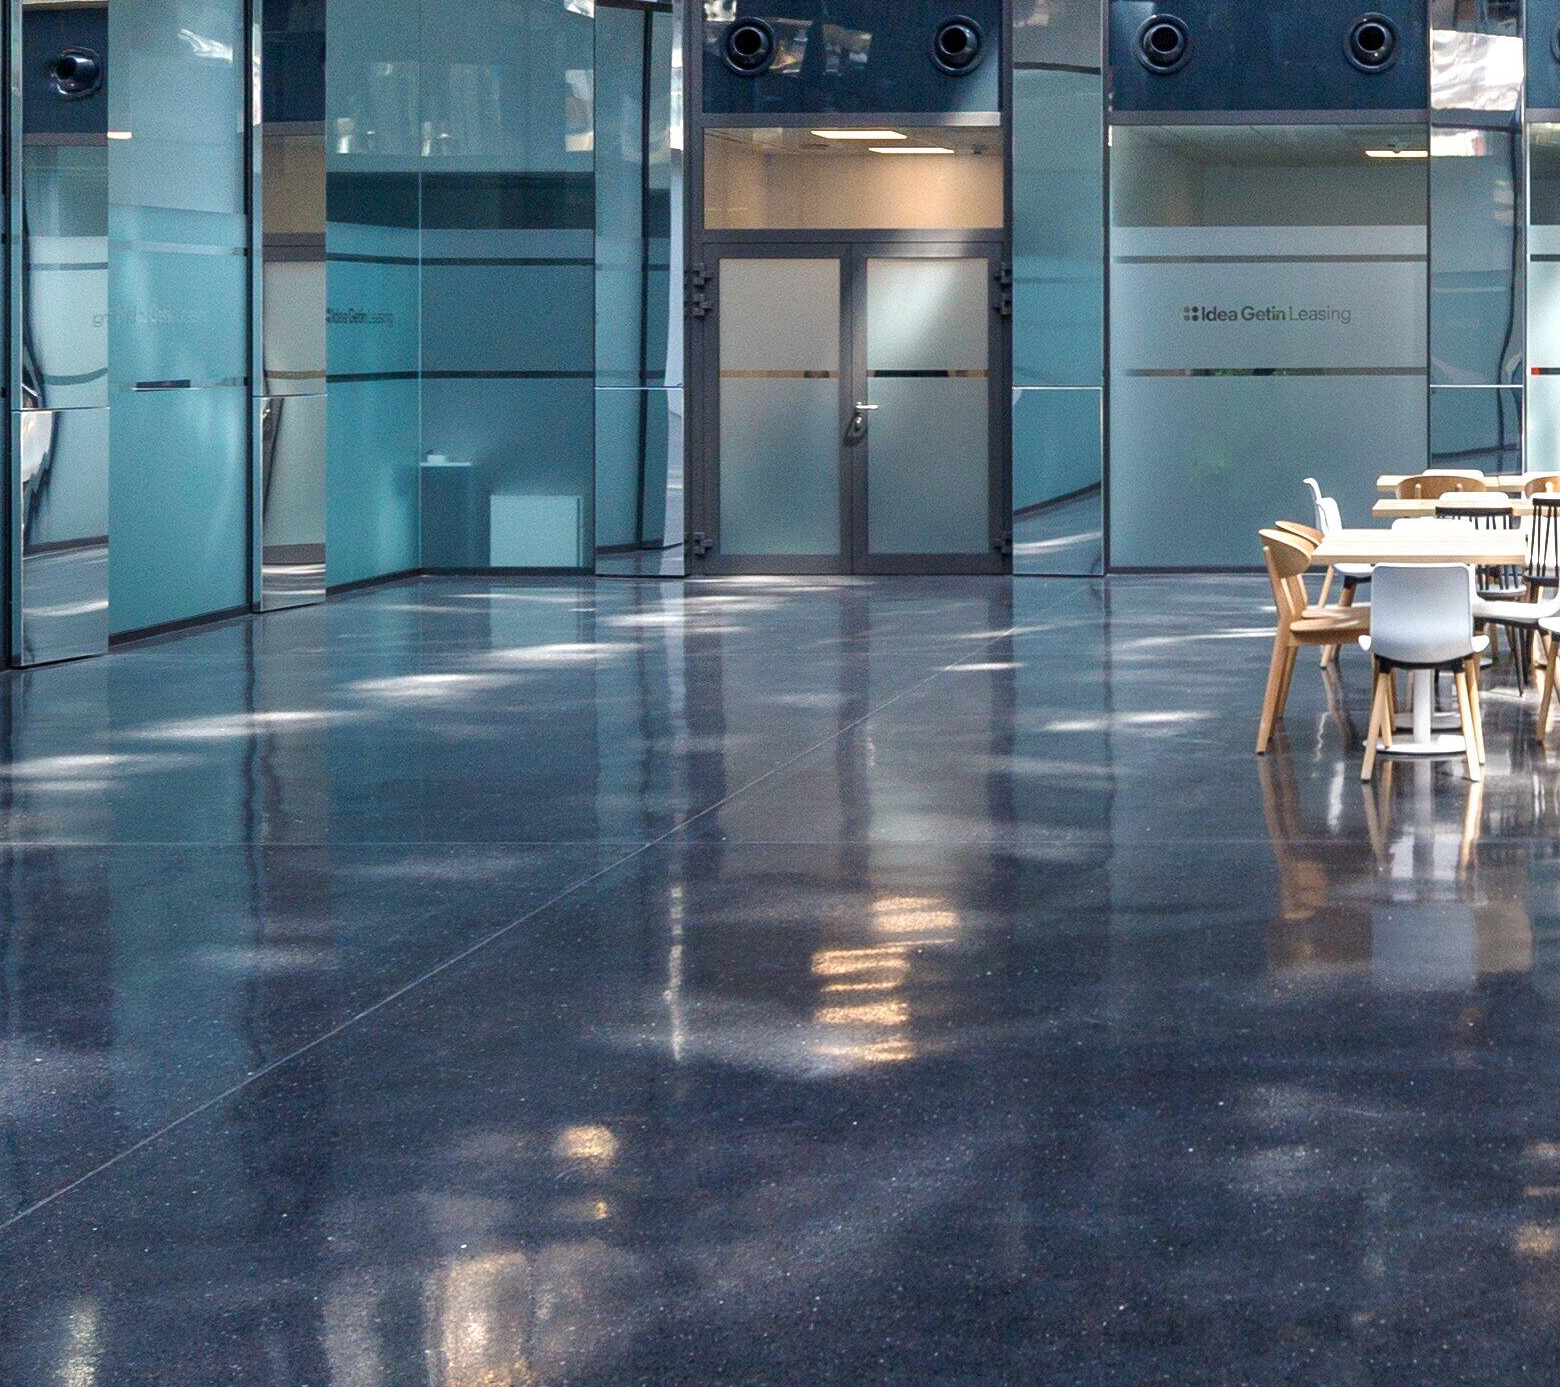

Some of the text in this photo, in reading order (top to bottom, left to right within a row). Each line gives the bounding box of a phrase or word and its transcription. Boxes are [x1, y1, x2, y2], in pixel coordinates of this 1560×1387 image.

[1201, 305, 1352, 325] Idea Getin Leasing
